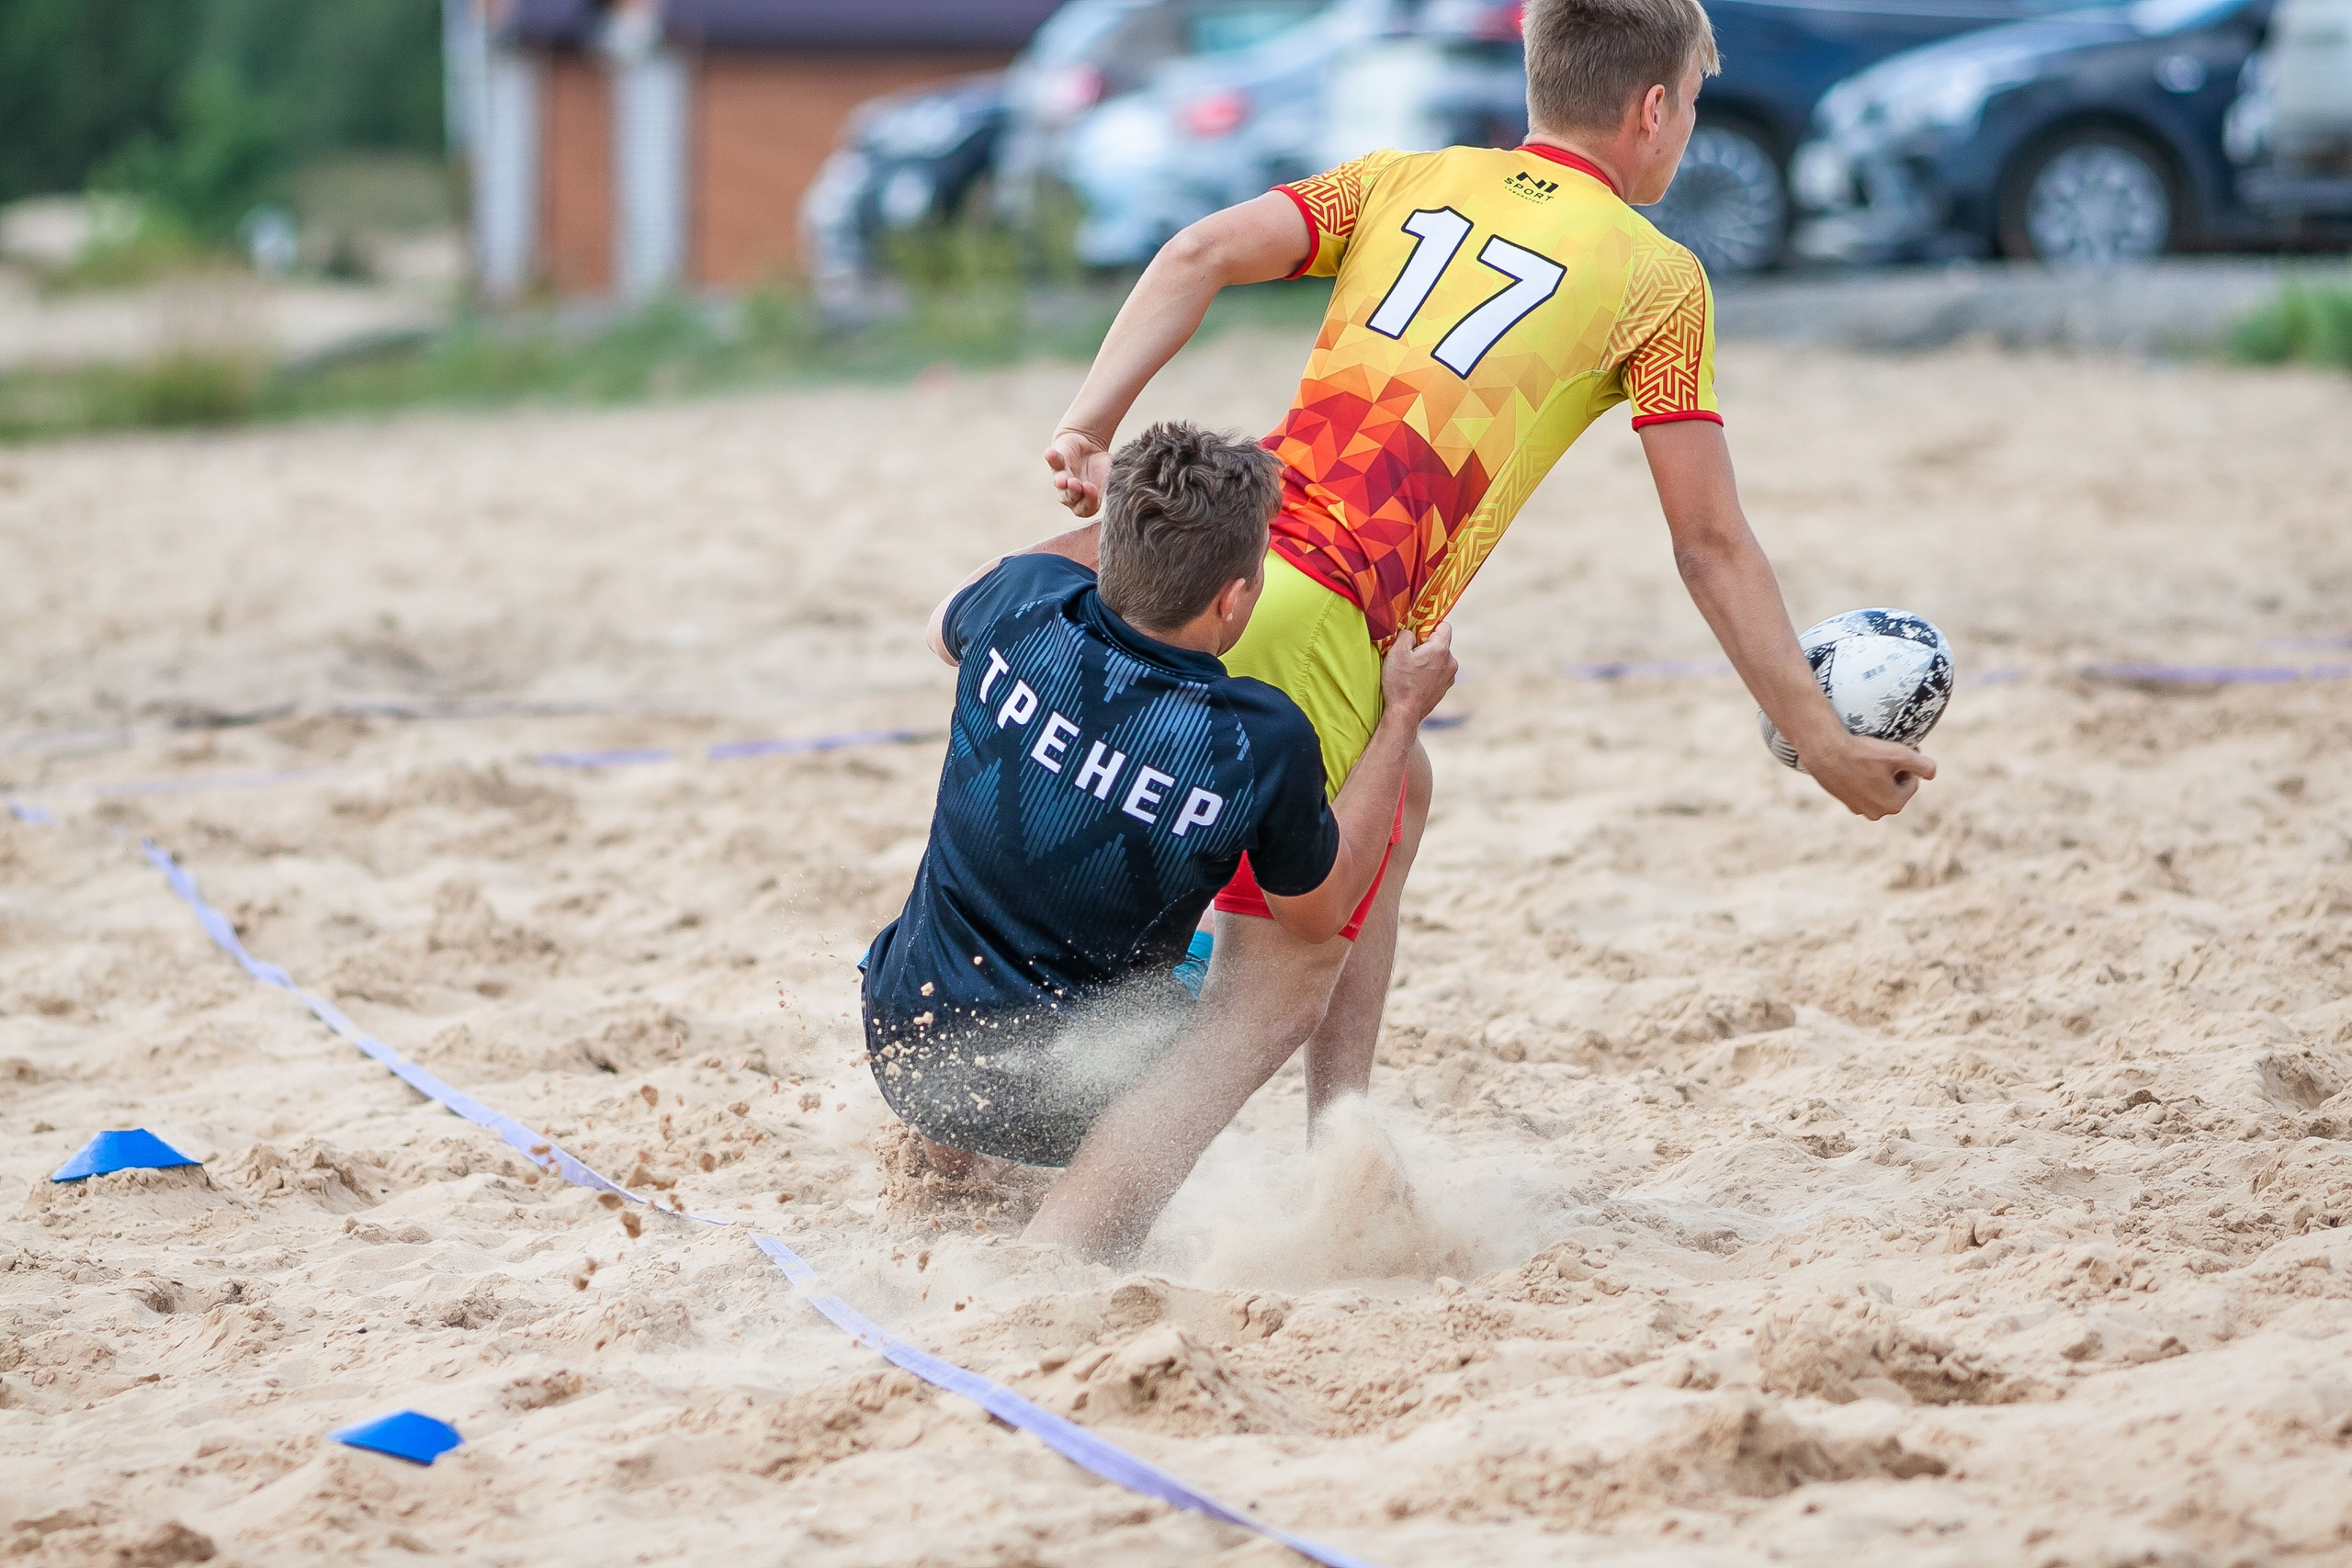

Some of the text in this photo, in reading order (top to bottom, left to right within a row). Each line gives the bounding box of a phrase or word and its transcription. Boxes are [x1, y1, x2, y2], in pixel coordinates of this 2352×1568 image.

[1504, 177, 1555, 201] SPORT
[1504, 186, 1544, 205] LABORATORY
[1365, 205, 1567, 380] 17
[978, 647, 1224, 837] ТРЕНЕР
